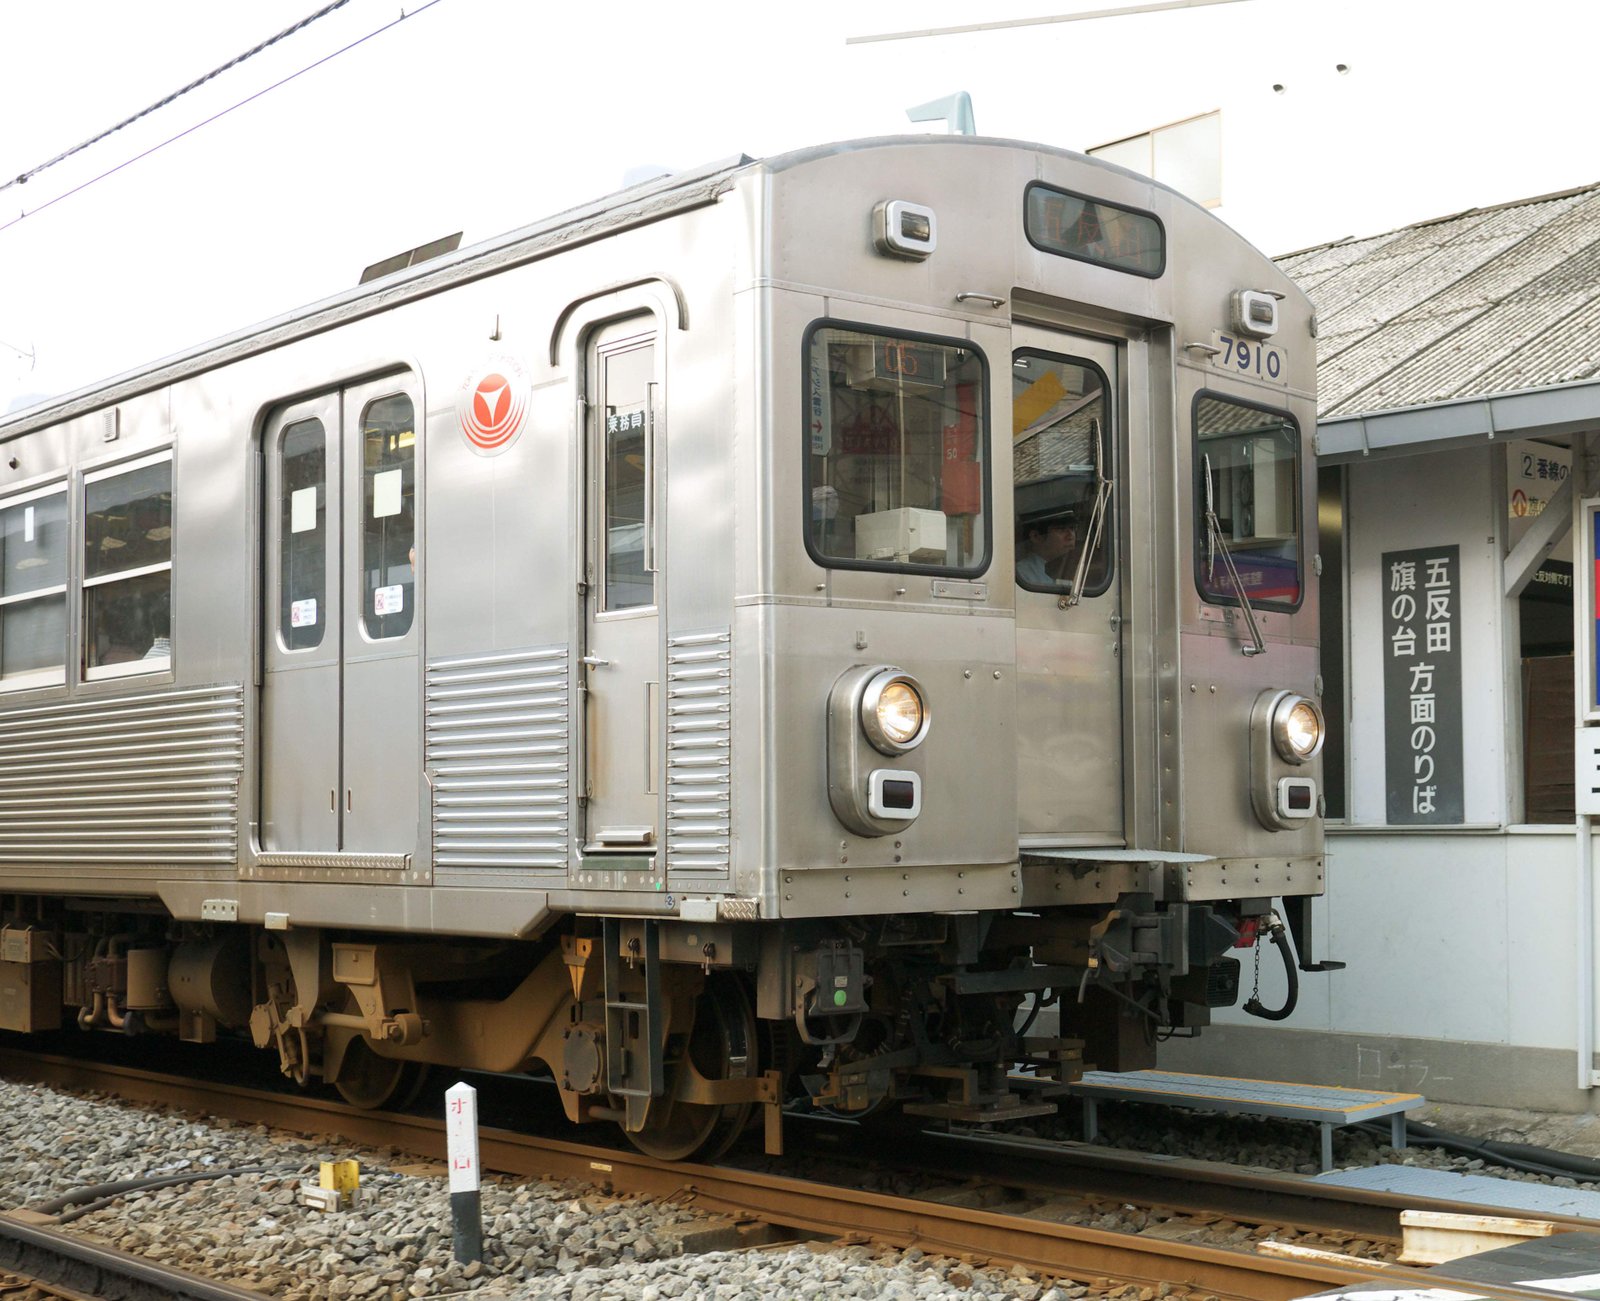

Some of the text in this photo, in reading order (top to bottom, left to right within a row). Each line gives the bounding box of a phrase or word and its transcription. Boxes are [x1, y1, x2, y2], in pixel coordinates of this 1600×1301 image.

[1220, 335, 1281, 378] 7910
[608, 411, 647, 433] 乗務員
[1391, 561, 1417, 657] 旗の台
[1425, 557, 1452, 653] 五反田
[1409, 661, 1437, 815] 方面のりば
